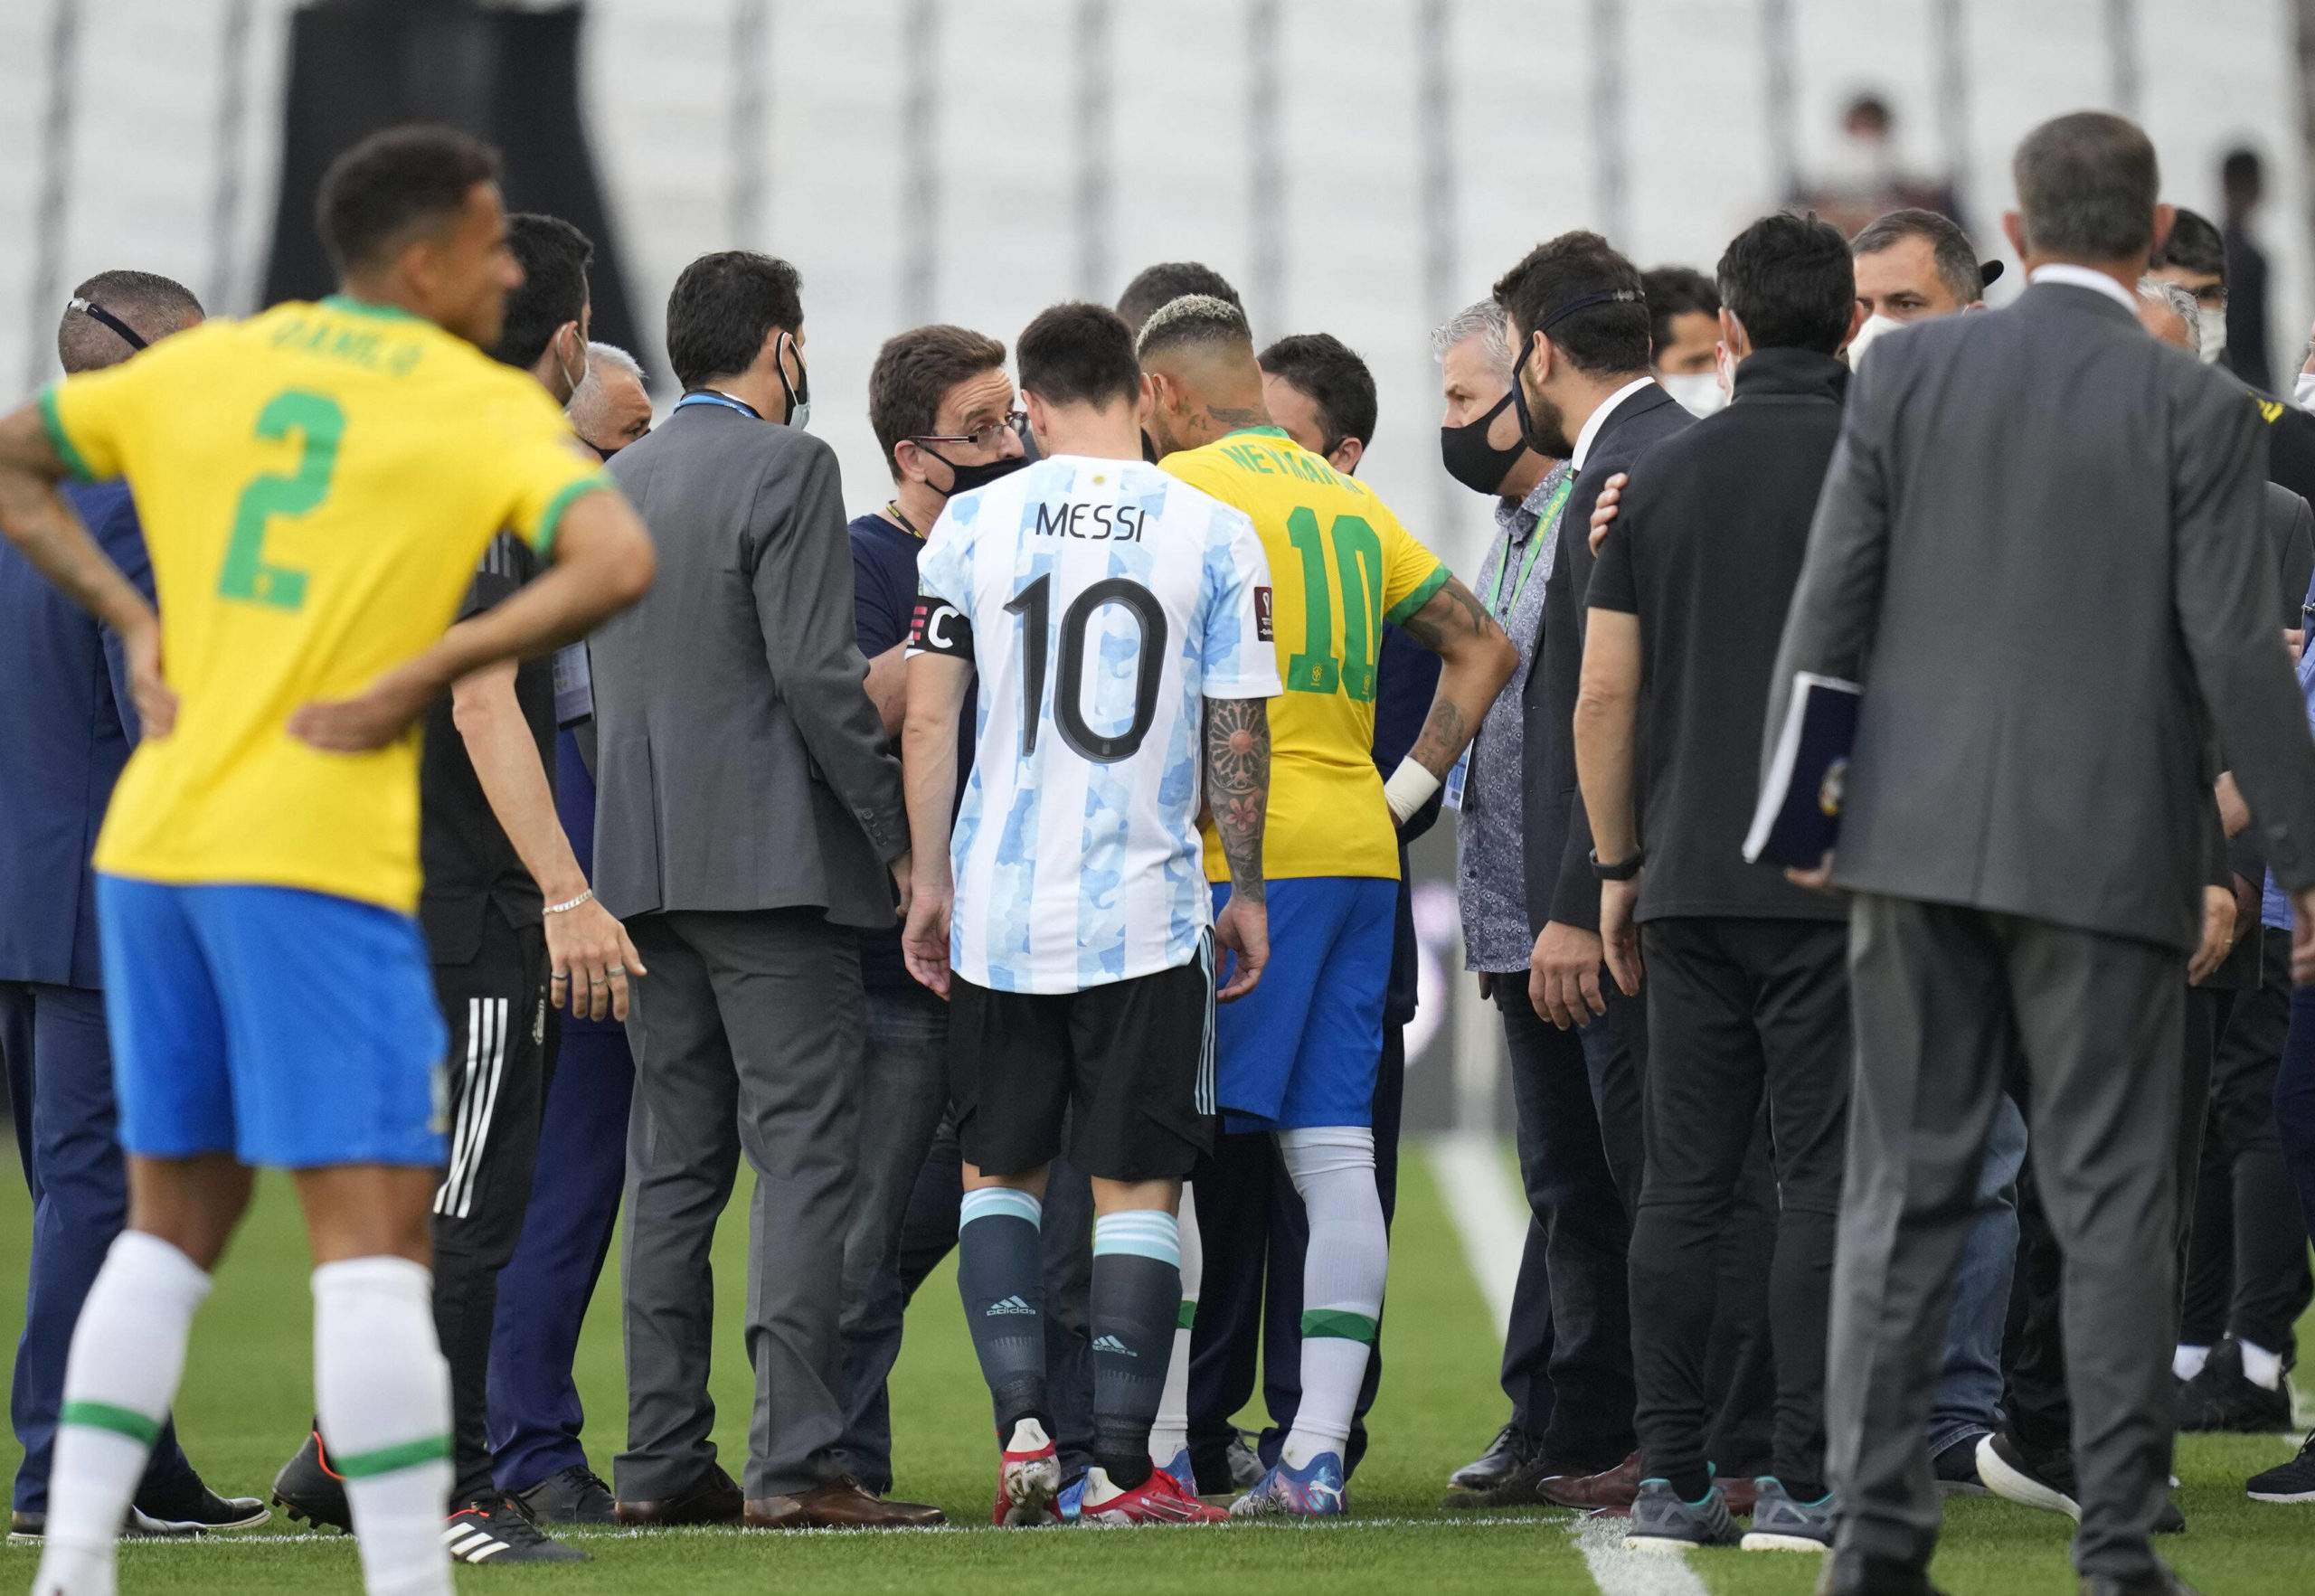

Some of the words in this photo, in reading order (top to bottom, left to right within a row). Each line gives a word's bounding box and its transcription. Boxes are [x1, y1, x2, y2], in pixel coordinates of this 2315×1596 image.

[218, 389, 347, 610] 2
[1035, 502, 1145, 543] MESSI
[928, 606, 959, 648] C
[1286, 506, 1383, 702] 10
[1003, 572, 1167, 763] 10
[987, 1307, 1036, 1316] adidas
